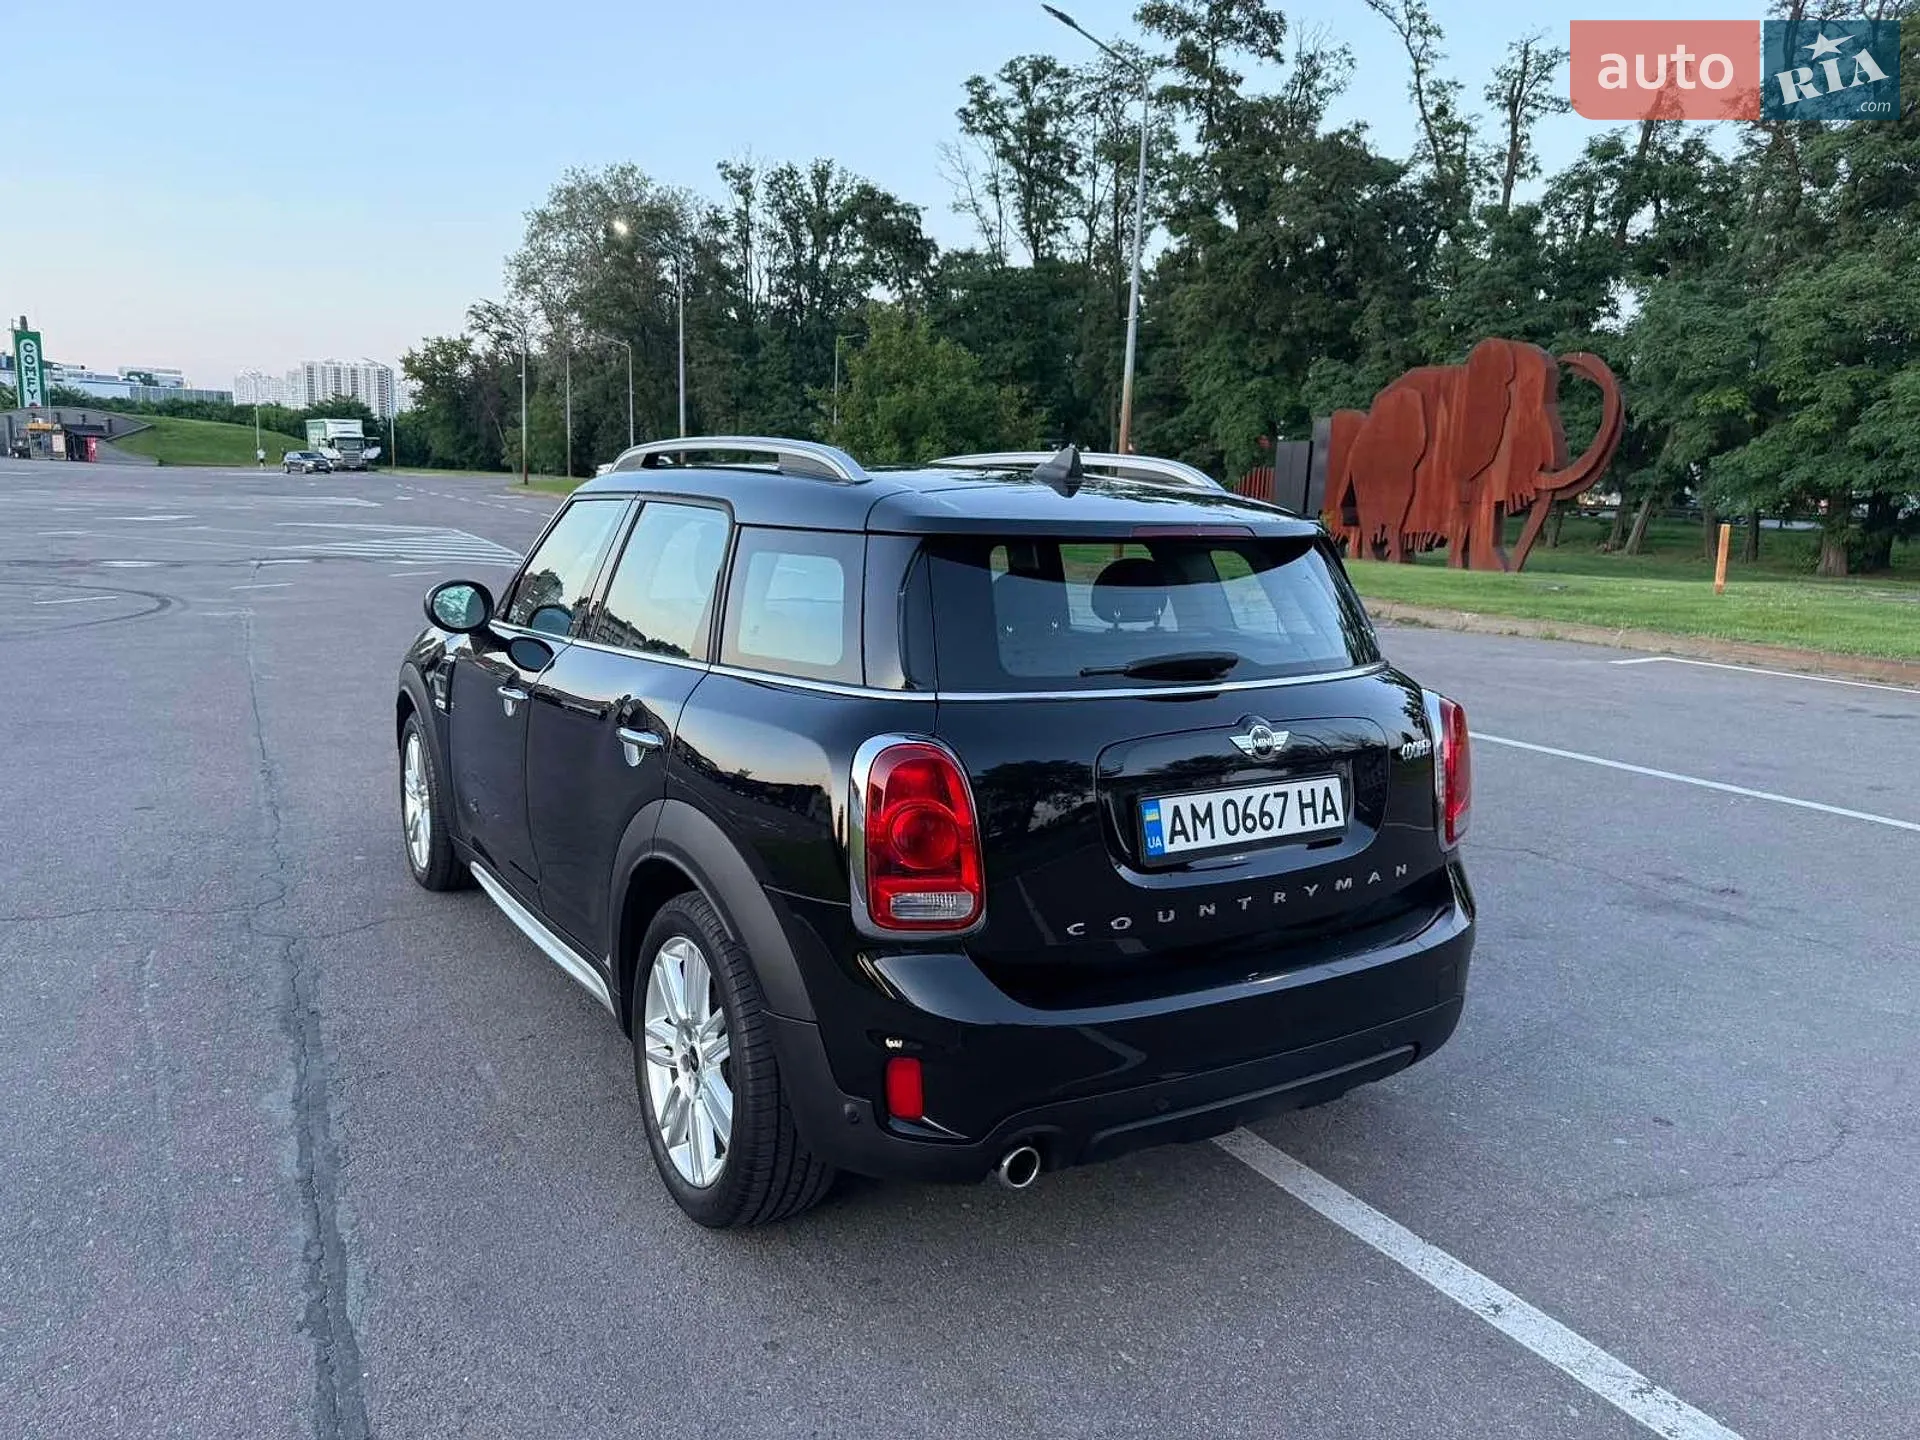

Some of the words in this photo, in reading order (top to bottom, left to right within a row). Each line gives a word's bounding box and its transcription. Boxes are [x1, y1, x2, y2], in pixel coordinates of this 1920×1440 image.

[23, 342, 37, 400] COMFY
[1147, 839, 1162, 849] UA
[1168, 801, 1216, 845] AM
[1222, 791, 1289, 837] 0667
[1297, 786, 1340, 827] HA
[1066, 863, 1408, 936] COUNTRYMAN
